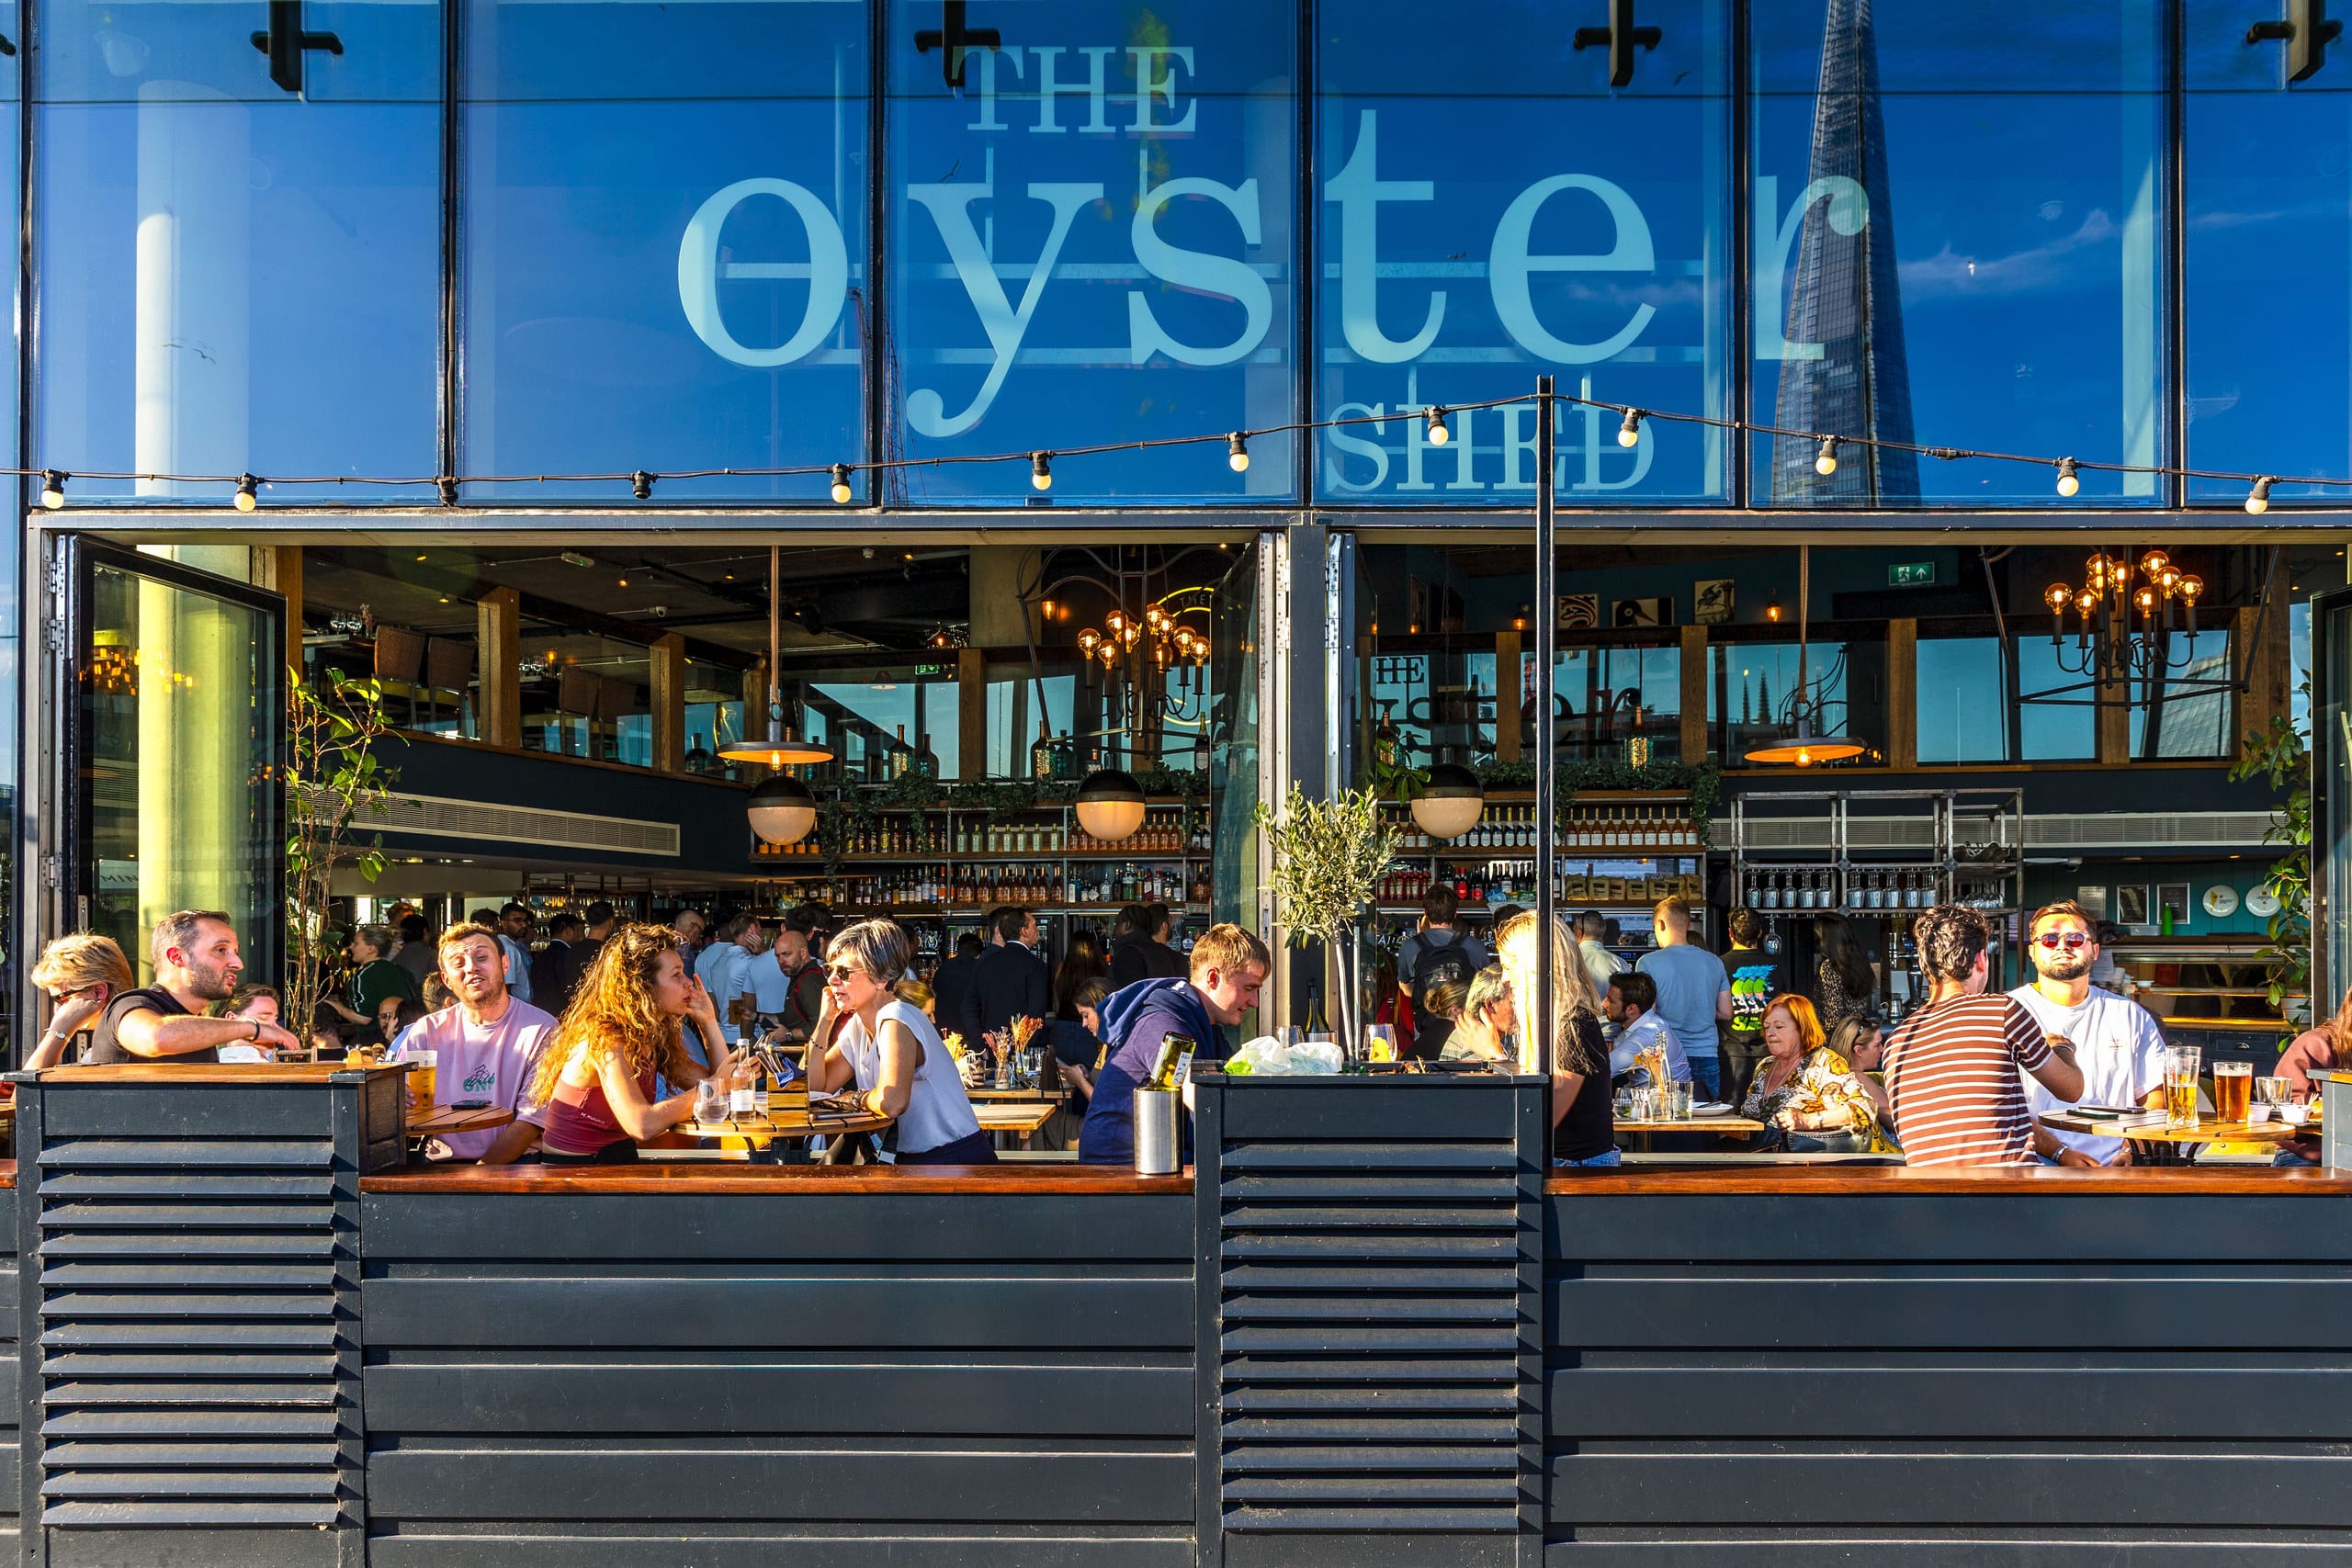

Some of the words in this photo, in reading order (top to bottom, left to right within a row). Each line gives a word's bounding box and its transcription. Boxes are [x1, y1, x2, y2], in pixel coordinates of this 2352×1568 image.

[951, 45, 1197, 133] THE
[678, 108, 1870, 438] oyster
[1326, 401, 1655, 492] SHED
[1375, 656, 1425, 684] HE
